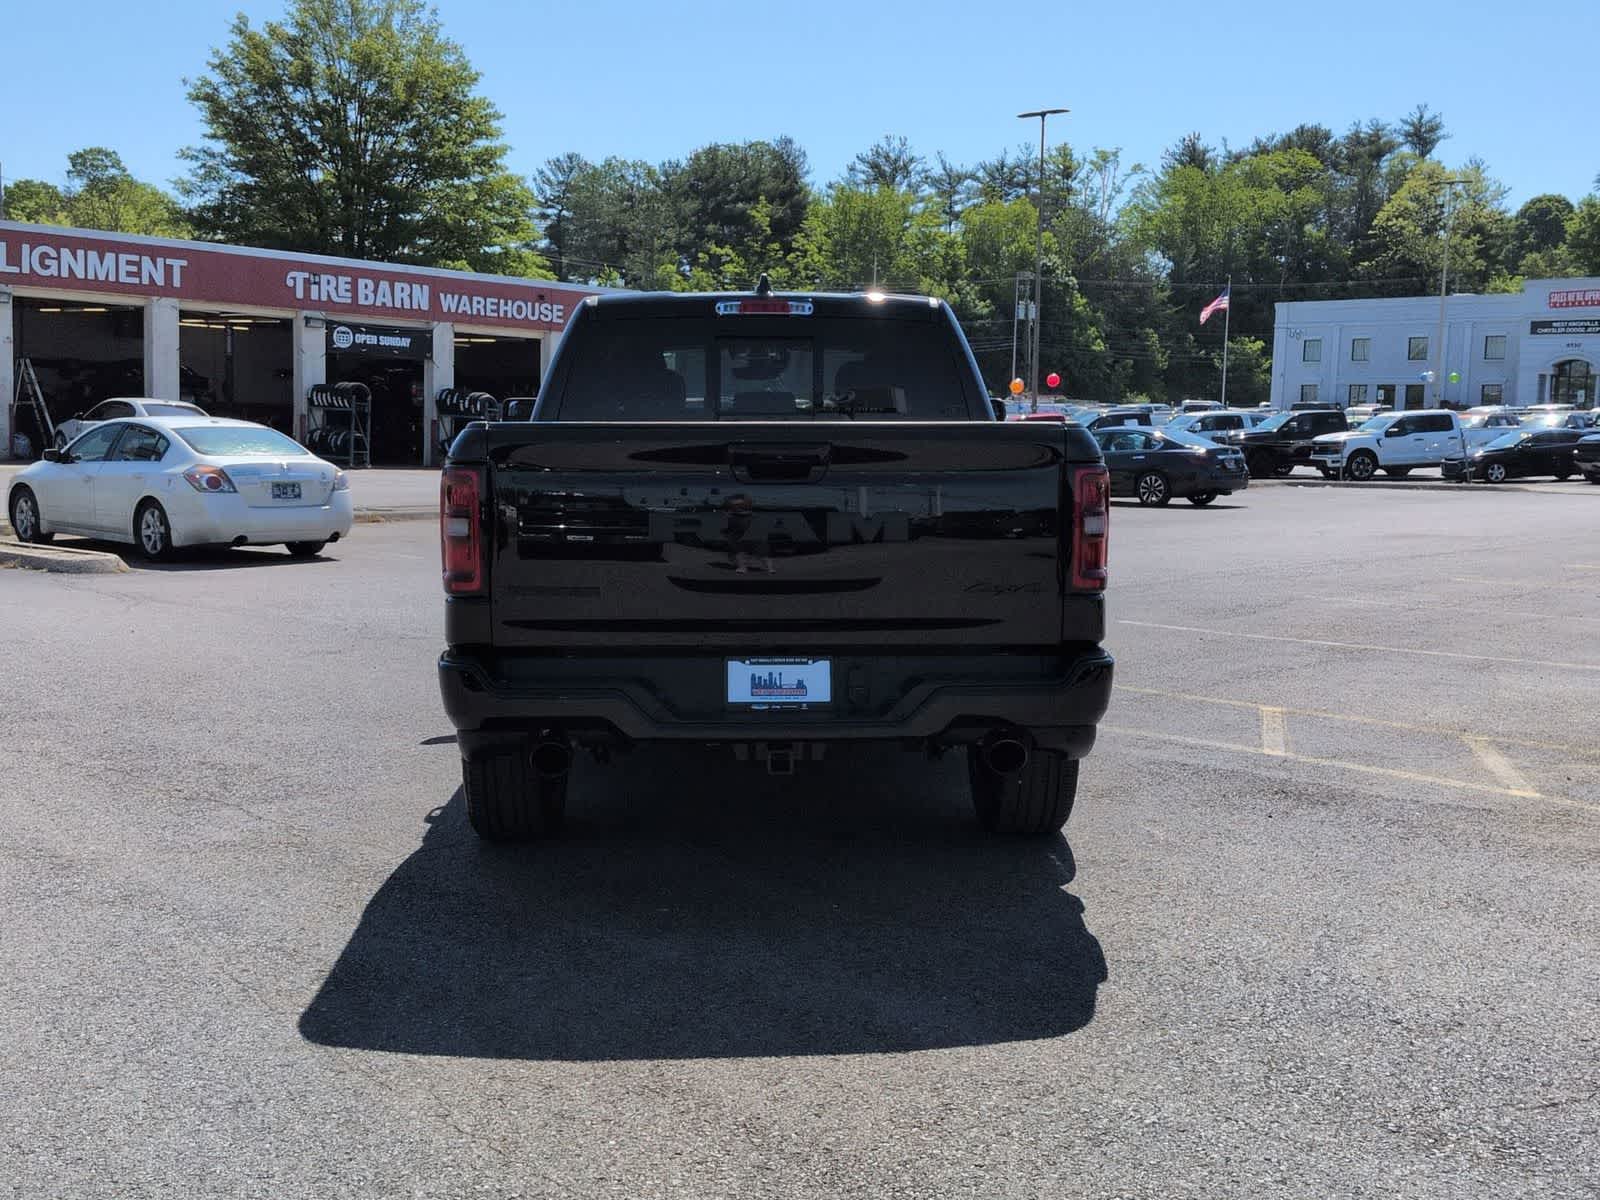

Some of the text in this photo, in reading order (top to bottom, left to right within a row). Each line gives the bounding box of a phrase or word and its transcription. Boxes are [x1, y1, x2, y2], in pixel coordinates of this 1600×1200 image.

[357, 278, 430, 311] BARN
[440, 292, 565, 324] WAREHOUSE
[354, 333, 411, 348] OPEN SUNDAY
[648, 511, 911, 544] RAM
